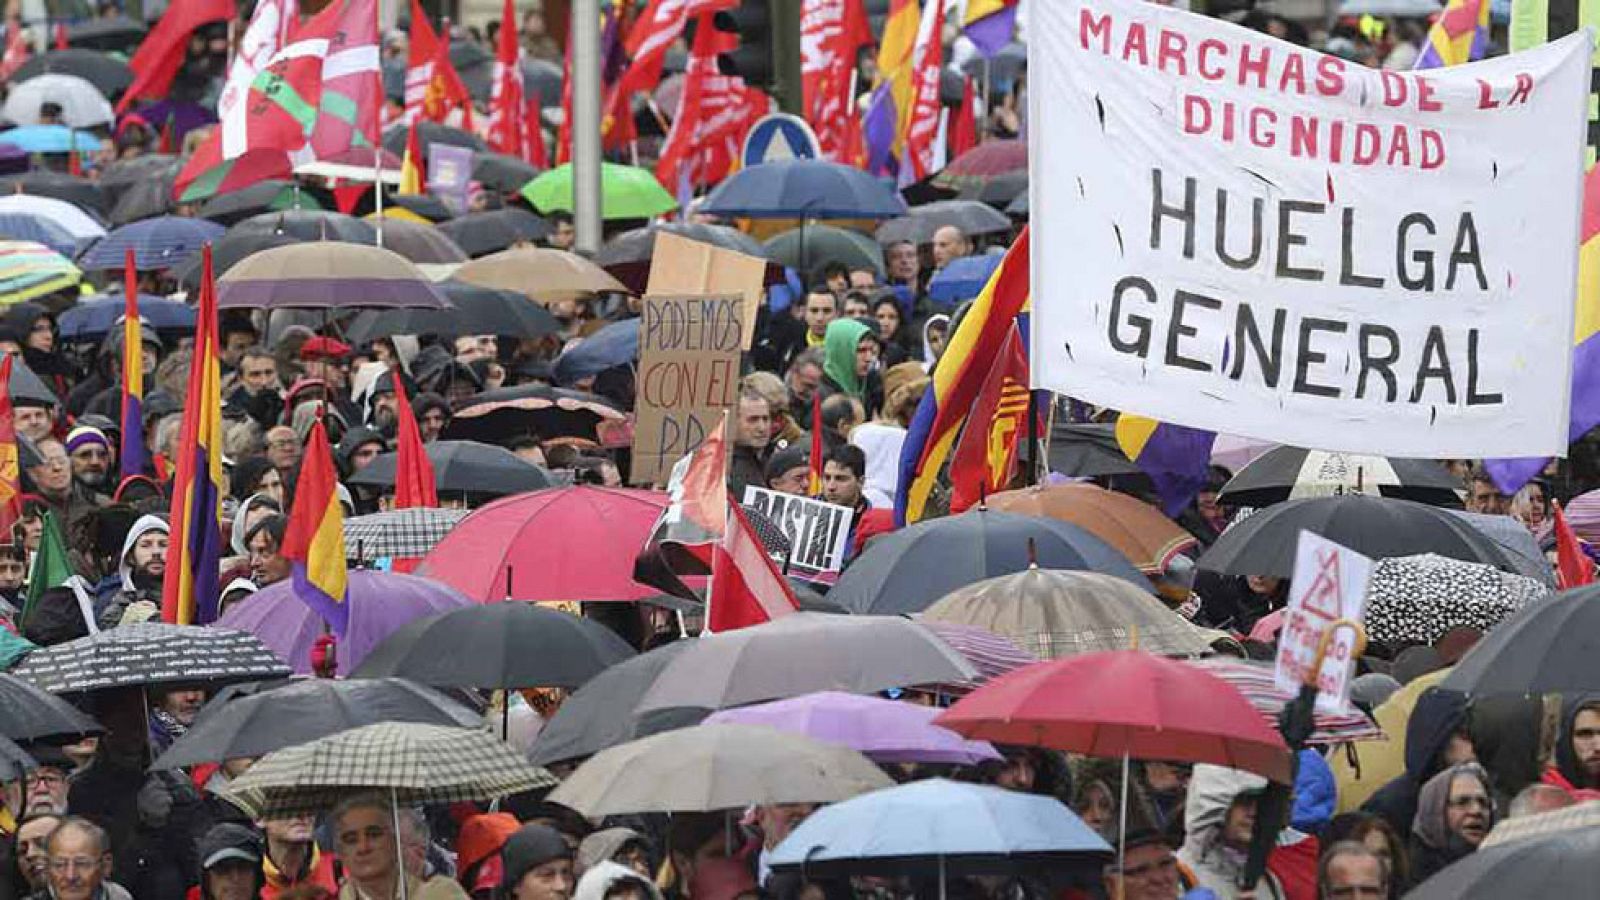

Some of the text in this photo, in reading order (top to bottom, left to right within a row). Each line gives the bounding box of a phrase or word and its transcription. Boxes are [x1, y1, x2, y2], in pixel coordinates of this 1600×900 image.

[1079, 9, 1534, 112] MARCHAS DE LA
[1184, 94, 1446, 170] DIGNIDAD
[1150, 168, 1489, 292] HUELGA
[644, 299, 743, 352] PODEMOS
[1107, 276, 1504, 406] GENERAL
[644, 359, 739, 410] CON EL
